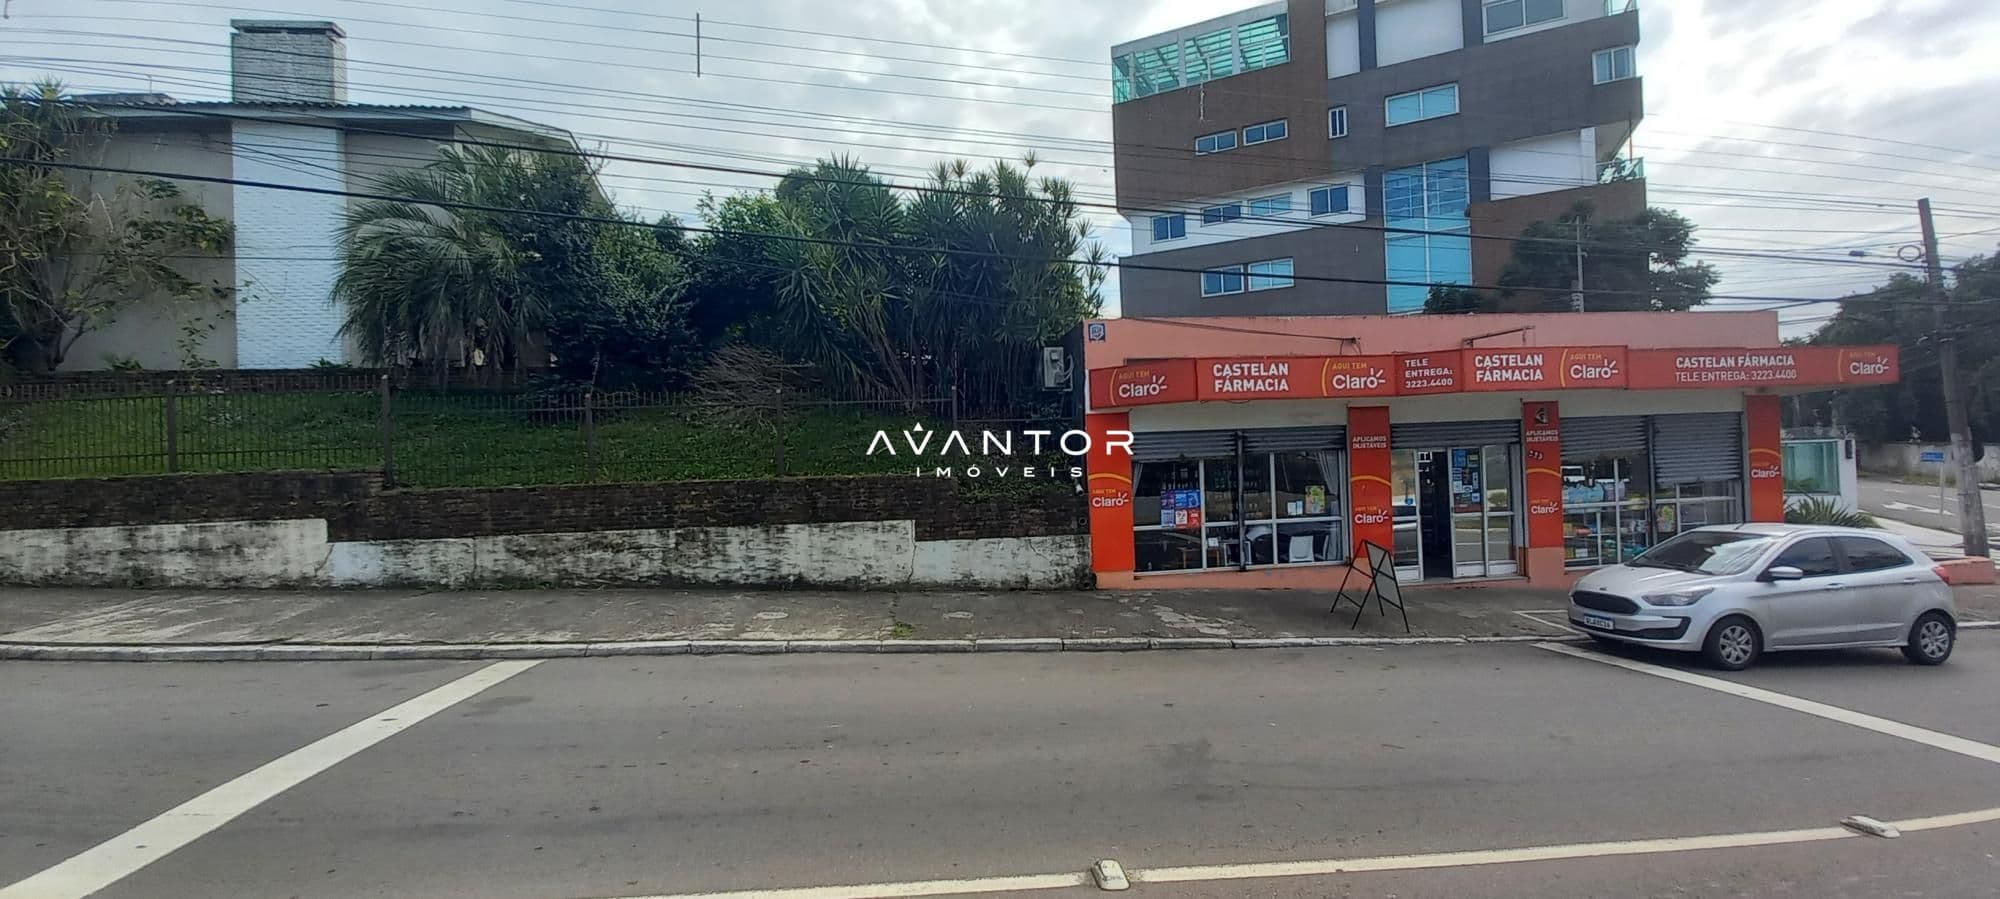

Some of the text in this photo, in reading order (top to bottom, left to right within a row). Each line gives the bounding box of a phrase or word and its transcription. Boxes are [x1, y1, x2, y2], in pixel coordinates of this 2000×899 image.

[1332, 362, 1350, 370] AQUI
[1404, 358, 1429, 367] TELE
[1474, 354, 1543, 367] CASTELAN
[1676, 353, 1795, 369] CASTELAN FÁRMACIA
[1213, 363, 1289, 377] CASTELAN
[1405, 368, 1453, 378] ENTREGA:
[1570, 362, 1615, 379] Claro
[1850, 360, 1886, 375] Claro
[1332, 371, 1381, 389] Claro
[1476, 368, 1544, 382] FÁRMACIA
[1675, 369, 1797, 382] TELE ENTREGA: 3223.4400
[1118, 379, 1163, 398] Claro
[1214, 375, 1290, 392] FÁRMACIA
[1405, 378, 1453, 389] 3223.4400
[1751, 467, 1778, 478] Claro
[1092, 495, 1126, 507] Claro
[1531, 504, 1556, 514] Claro
[1354, 512, 1386, 524] Claro
